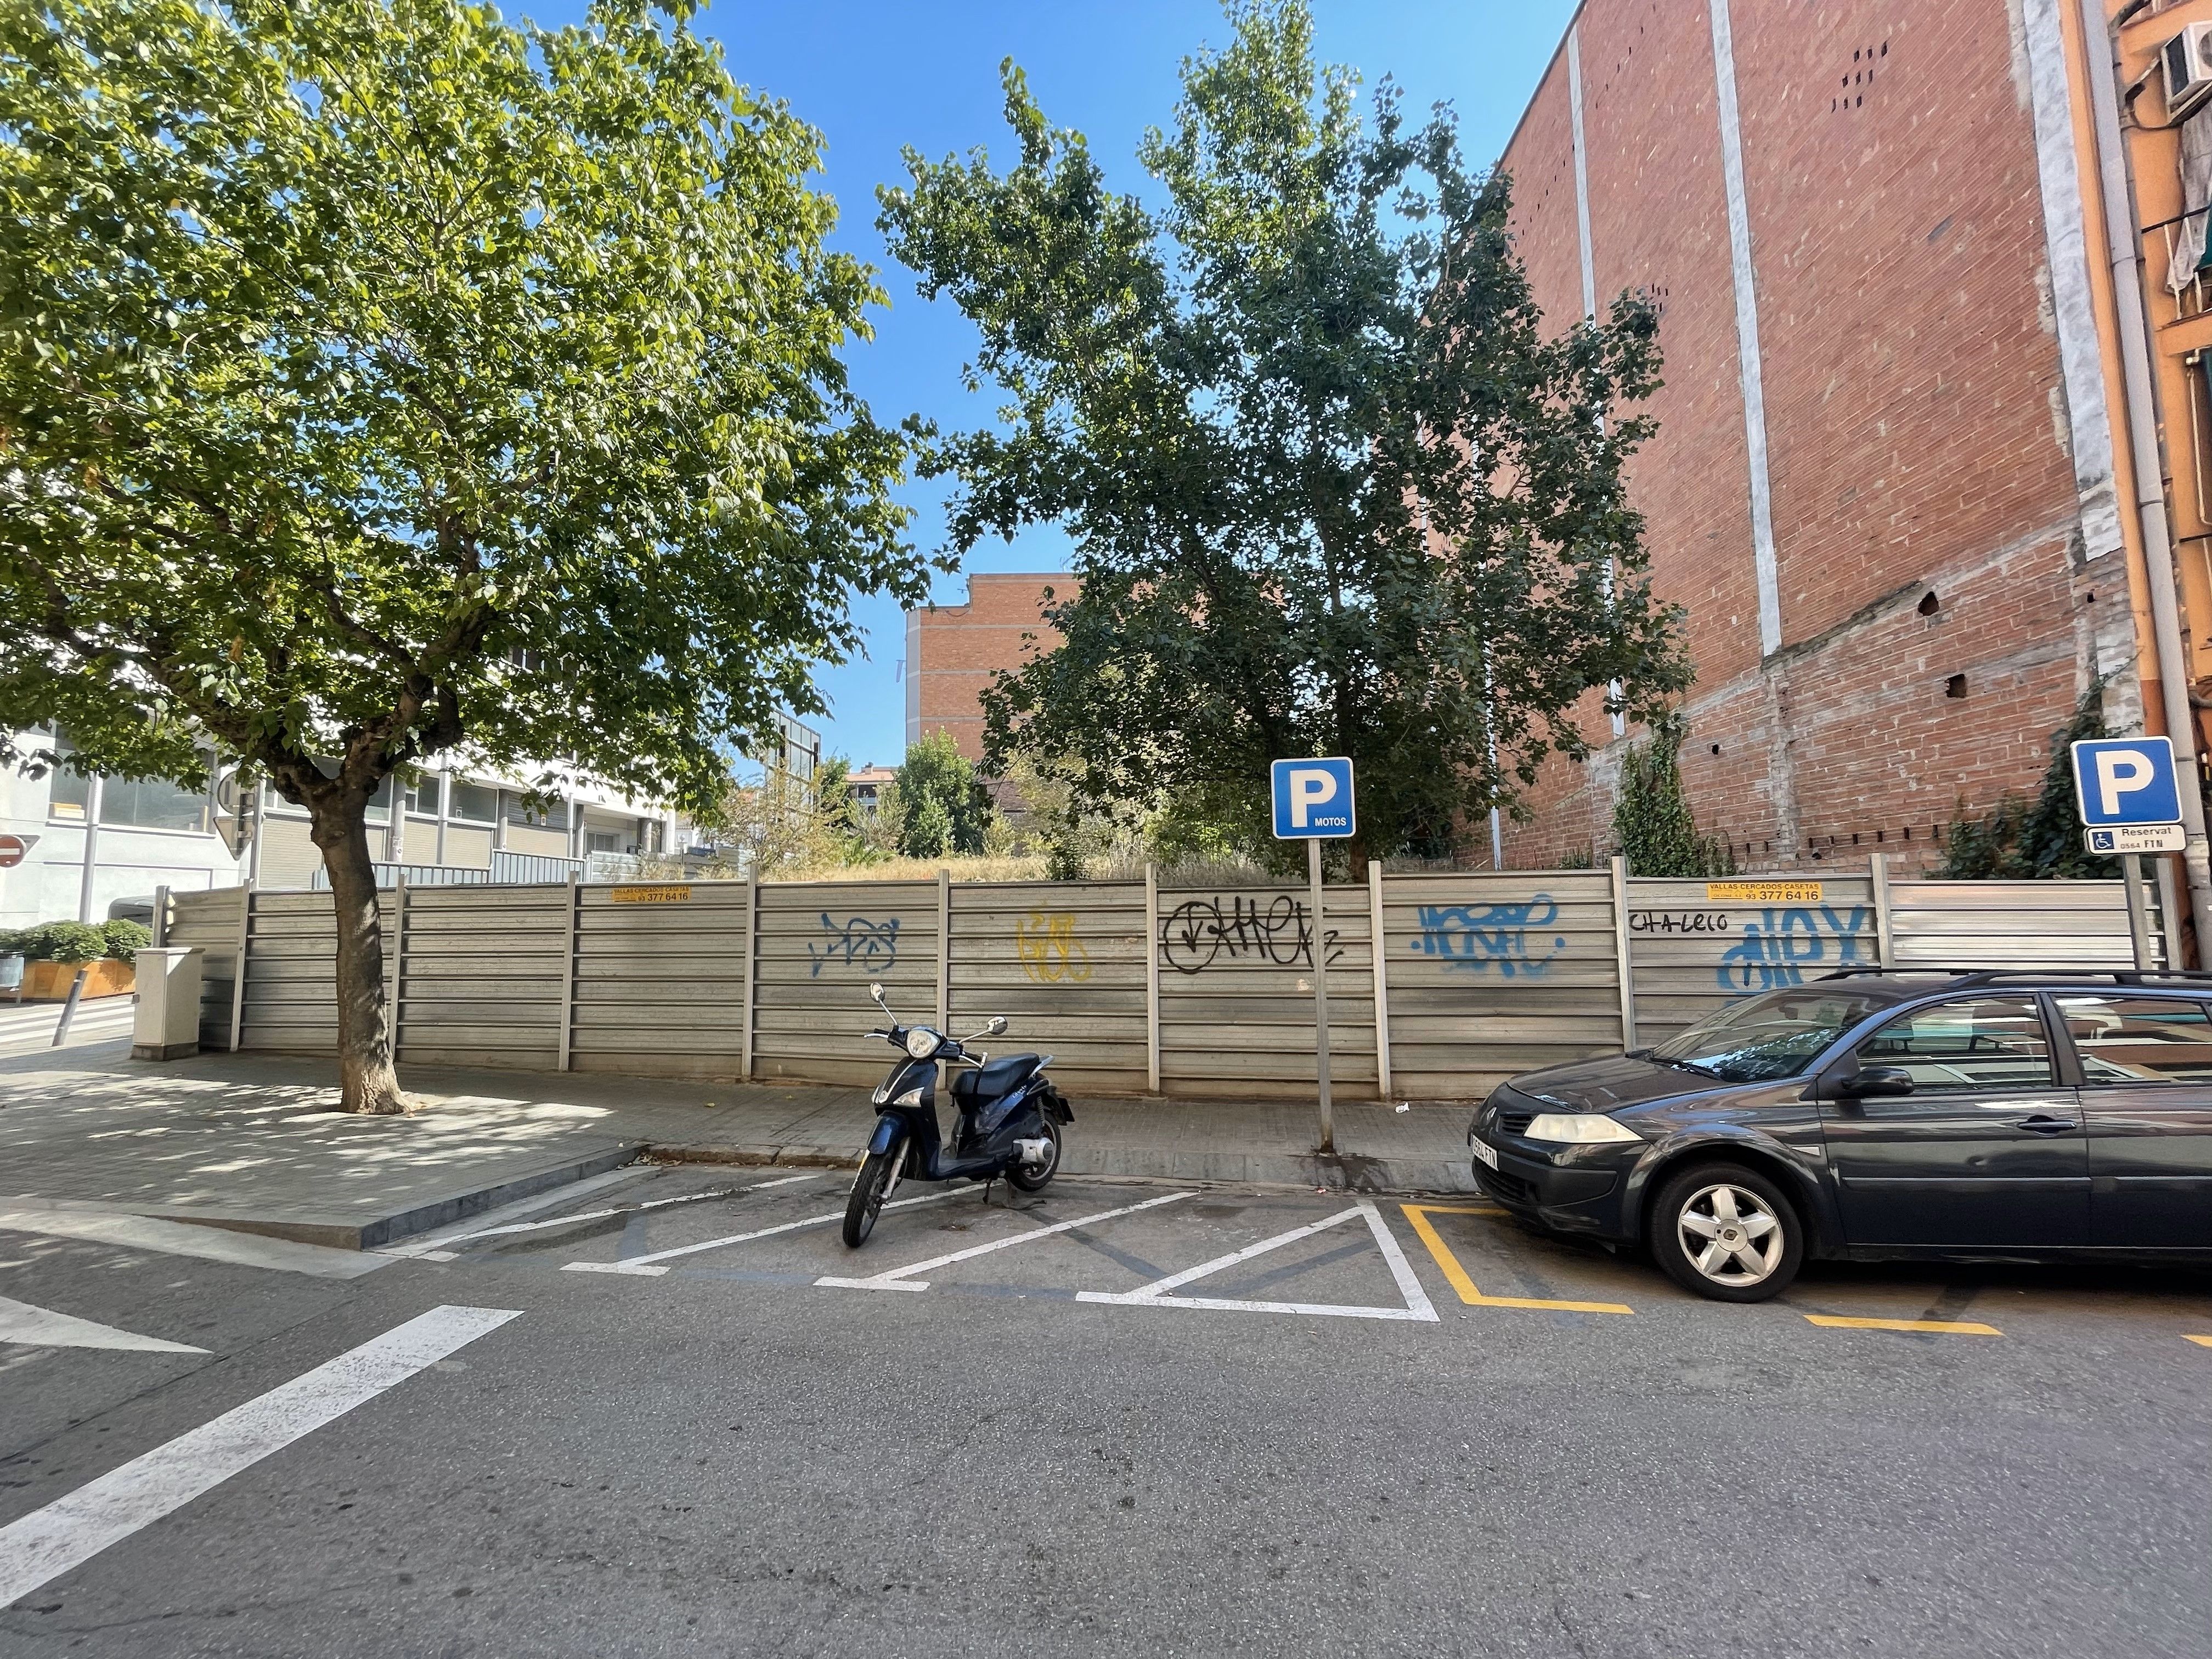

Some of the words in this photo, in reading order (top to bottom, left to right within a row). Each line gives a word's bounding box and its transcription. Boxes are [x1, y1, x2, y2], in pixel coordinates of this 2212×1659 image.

[2096, 750, 2154, 815] P
[1290, 769, 1337, 827] P
[1315, 817, 1346, 827] MOTOS
[2121, 827, 2171, 836] Reservat
[1759, 891, 1782, 900] 377
[1786, 891, 1801, 900] 64
[1804, 891, 1819, 900] 16
